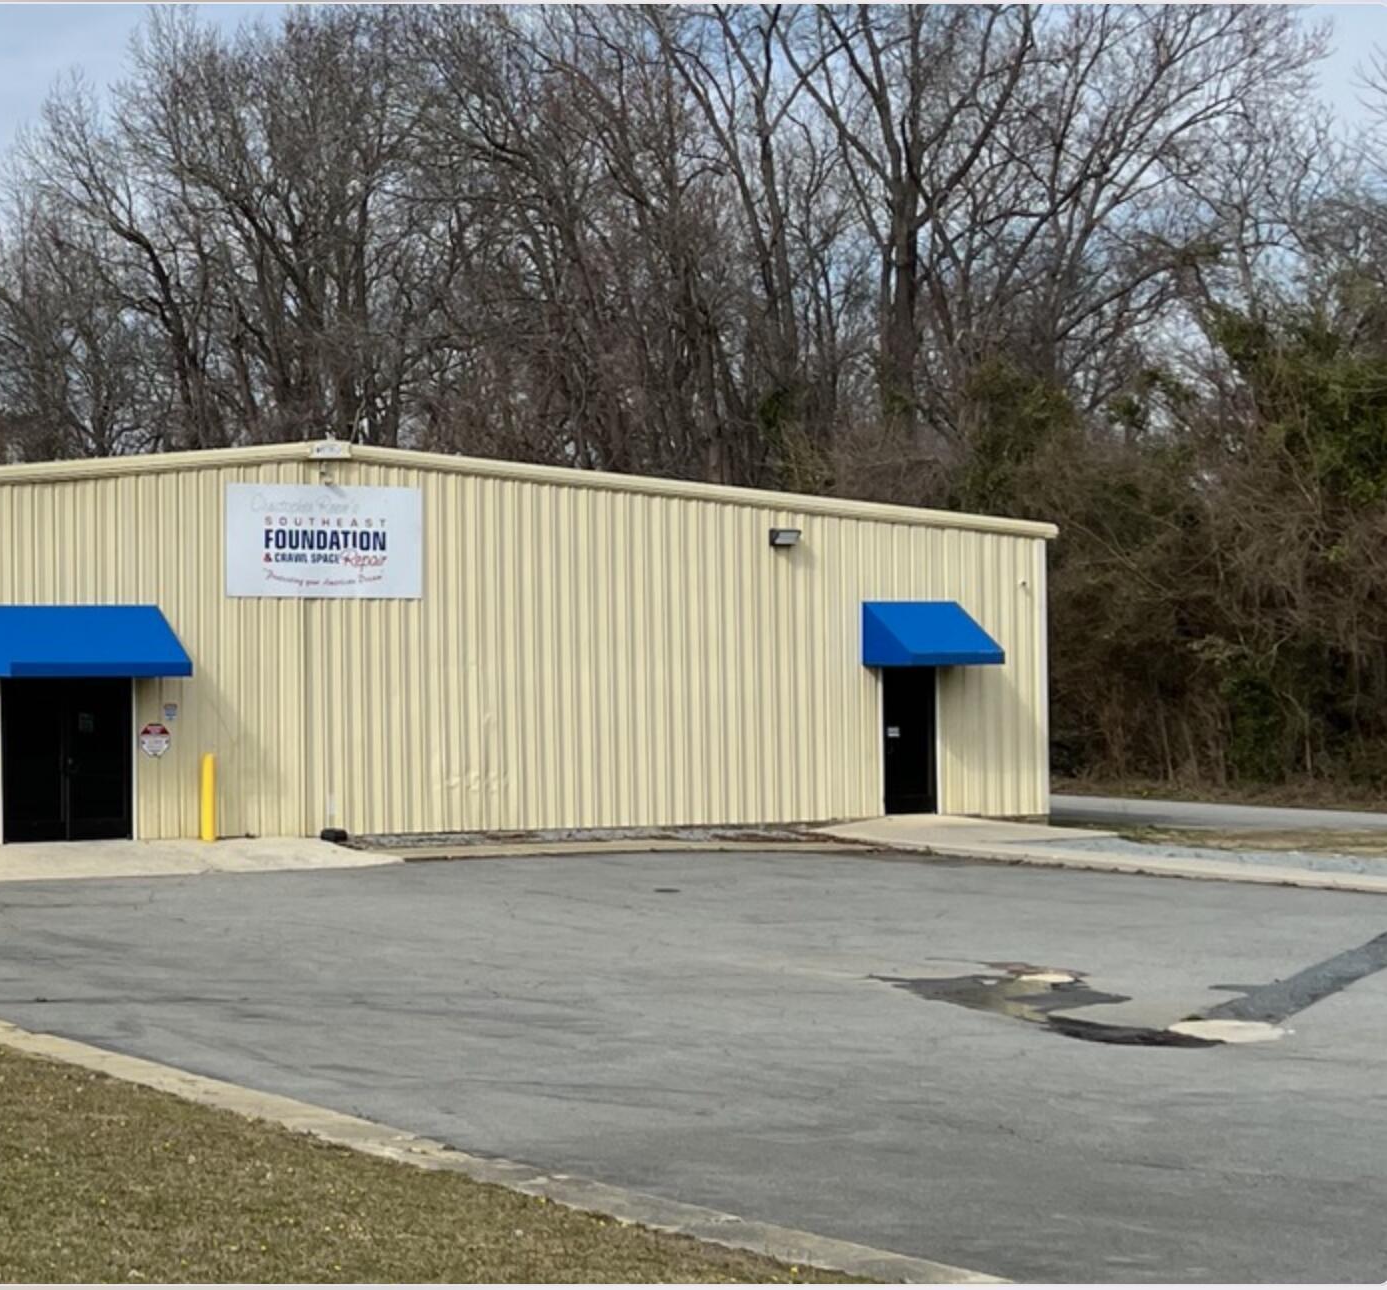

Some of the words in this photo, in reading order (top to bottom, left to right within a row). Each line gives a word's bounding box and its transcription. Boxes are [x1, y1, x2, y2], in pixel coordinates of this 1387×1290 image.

[264, 516, 387, 528] SOUTHEAST
[264, 528, 387, 552] FOUNDATION
[263, 552, 273, 563] &
[274, 552, 308, 564] CRAWL
[310, 553, 340, 565] SPACE
